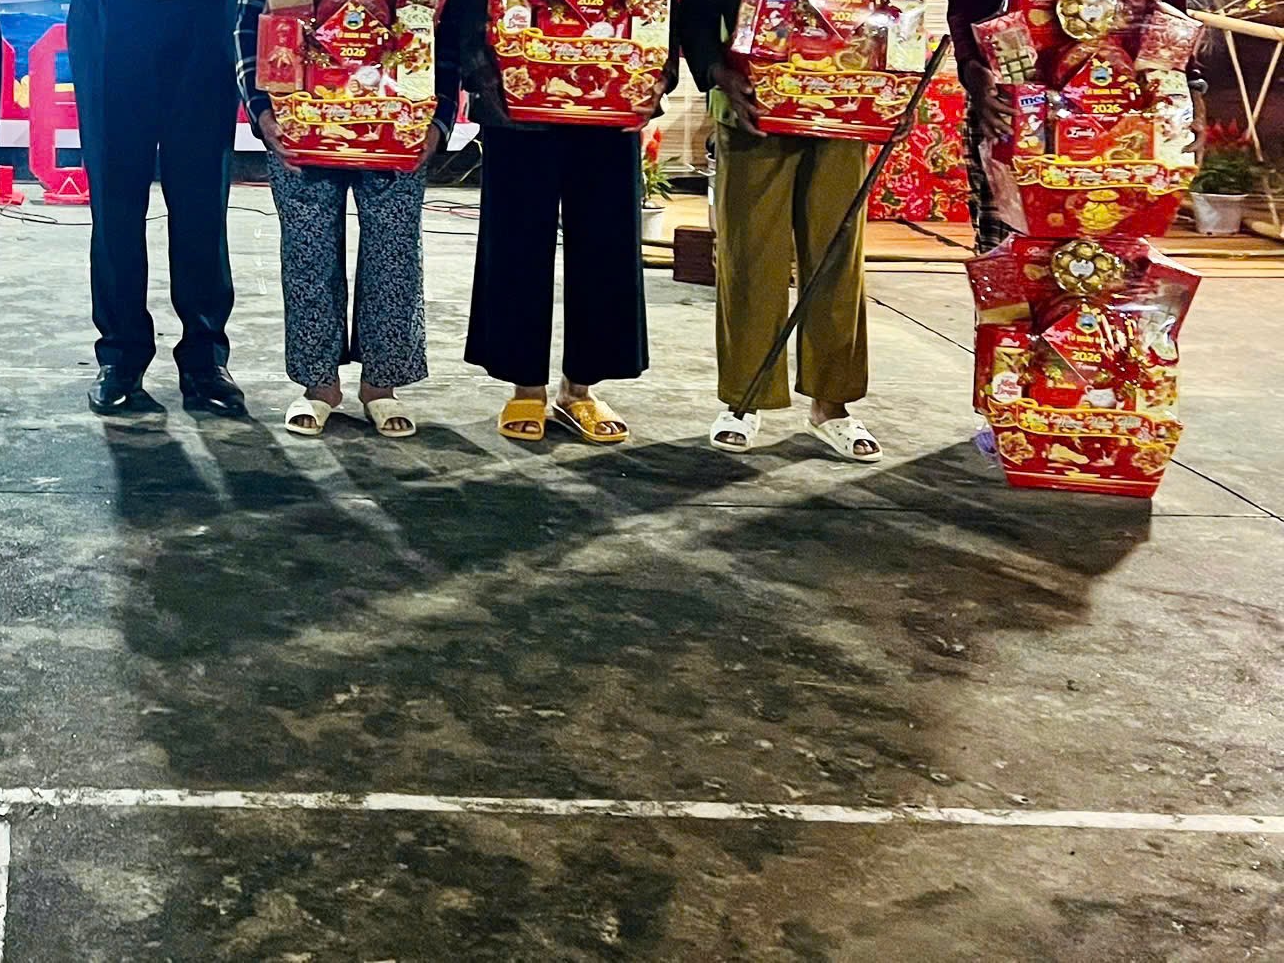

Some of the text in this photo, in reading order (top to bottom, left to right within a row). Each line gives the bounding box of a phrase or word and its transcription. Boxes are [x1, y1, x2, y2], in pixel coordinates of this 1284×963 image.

[340, 47, 366, 57] 2026
[1092, 103, 1121, 114] 2026
[1071, 350, 1102, 363] 2026
